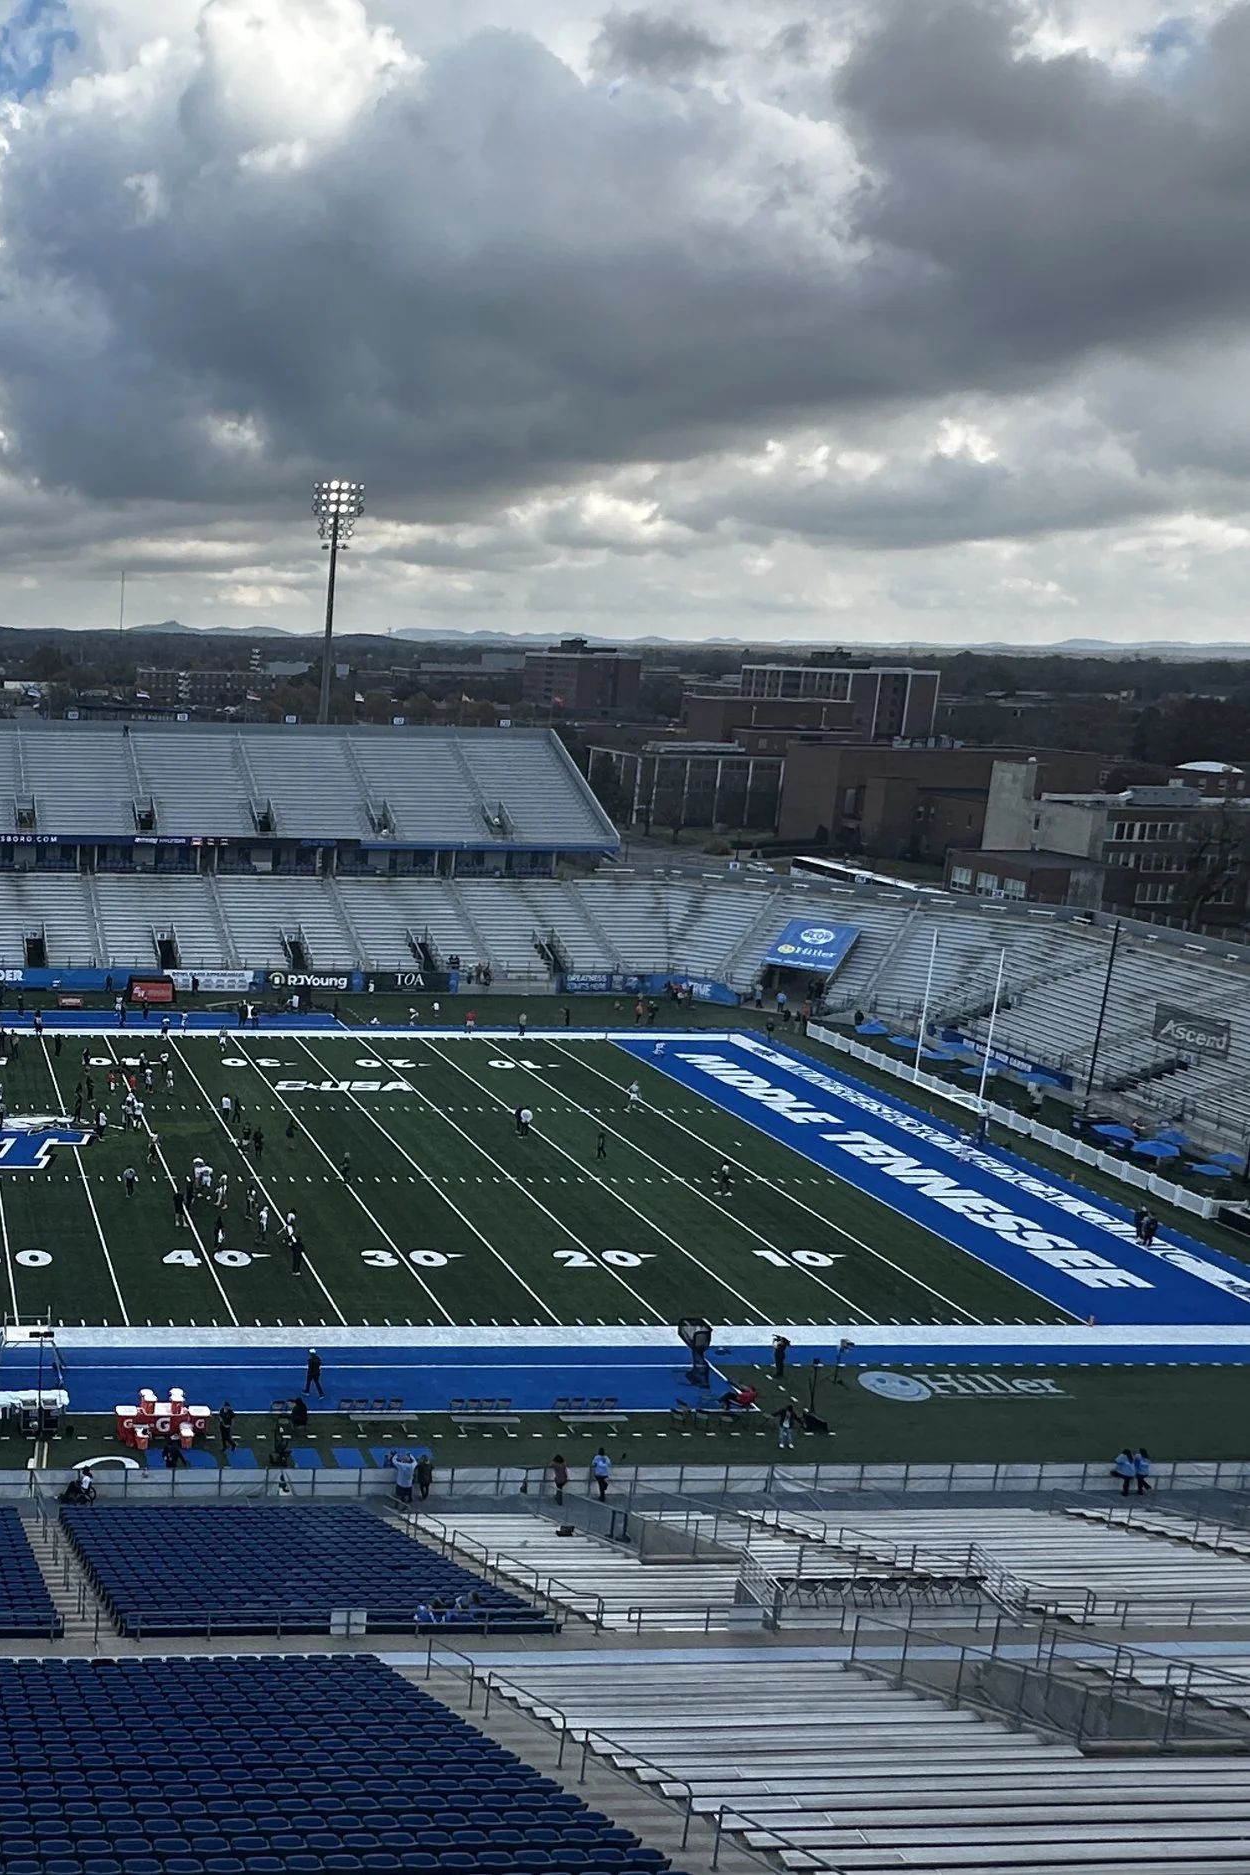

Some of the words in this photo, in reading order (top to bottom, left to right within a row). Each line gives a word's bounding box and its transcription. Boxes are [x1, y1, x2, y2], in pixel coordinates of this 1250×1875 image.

[394, 973, 425, 986] TOA
[1160, 1019, 1228, 1050] Ascend
[354, 1058, 416, 1068] 20
[674, 1053, 845, 1124] MIDDLE
[818, 1130, 1156, 1288] TENNESSEE
[162, 1249, 252, 1267] 40
[360, 1249, 448, 1268] 30
[553, 1249, 642, 1267] 20
[751, 1249, 835, 1267] 10
[911, 1373, 1066, 1395] Hiller
[123, 1418, 133, 1429] G
[155, 1417, 171, 1433] G
[195, 1419, 206, 1429] G
